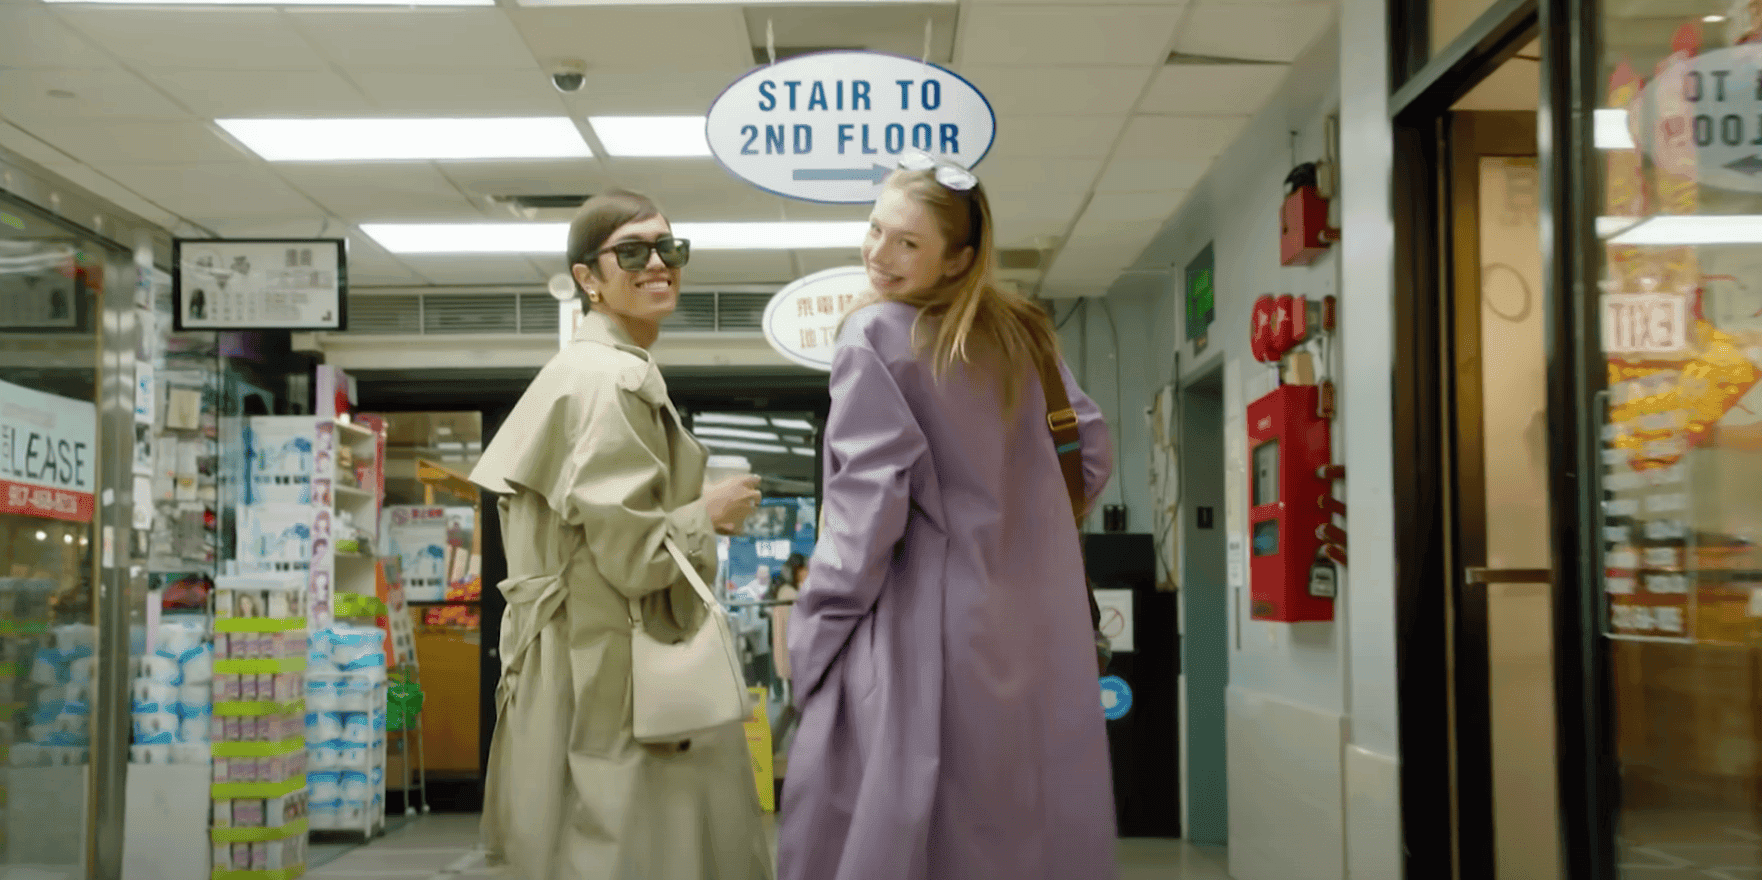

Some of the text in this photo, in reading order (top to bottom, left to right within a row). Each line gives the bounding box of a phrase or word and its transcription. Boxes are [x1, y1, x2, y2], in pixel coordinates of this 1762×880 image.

[758, 79, 941, 112] STAIR TO
[740, 122, 960, 155] 2ND FLOOR
[11, 427, 87, 486] LEASE
